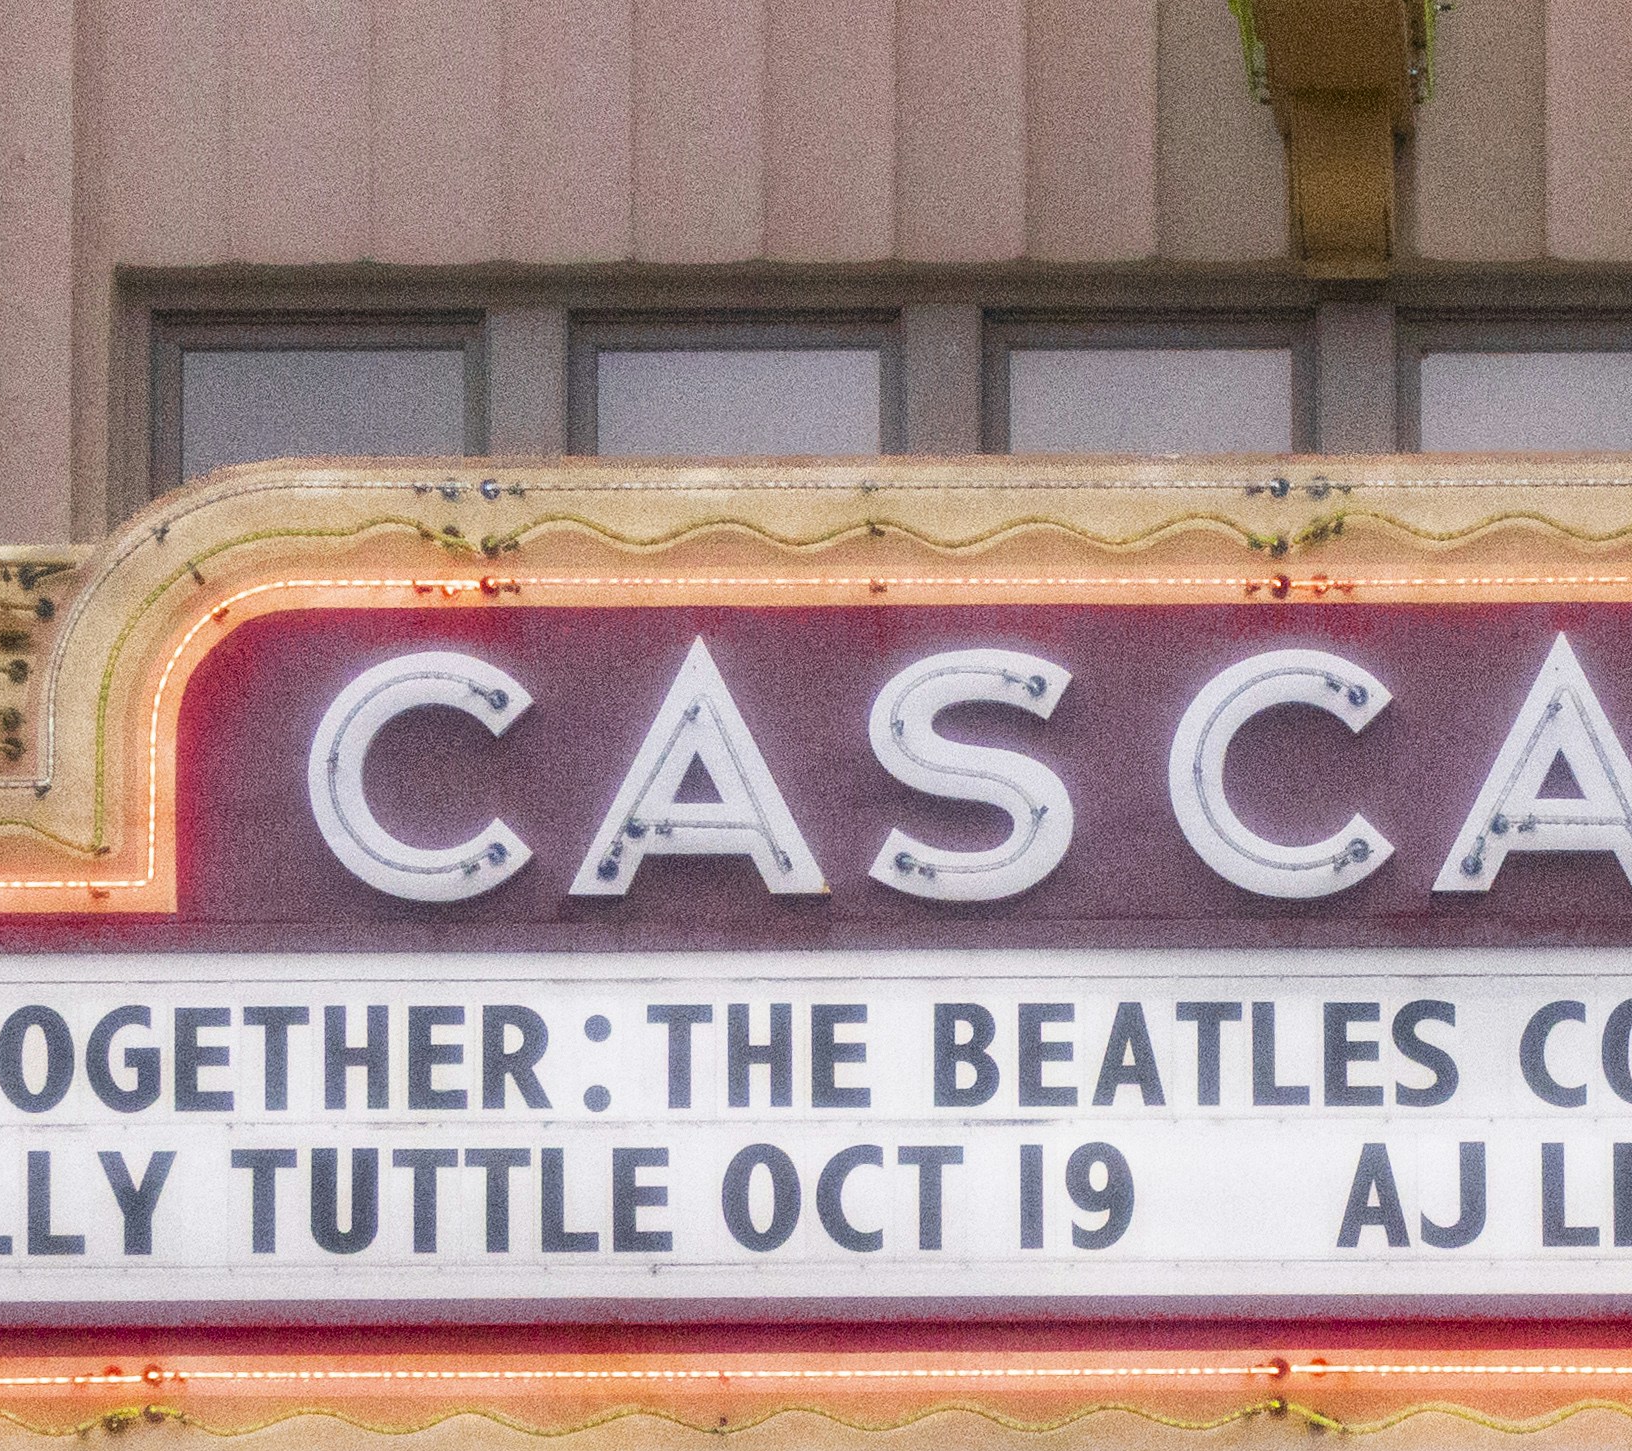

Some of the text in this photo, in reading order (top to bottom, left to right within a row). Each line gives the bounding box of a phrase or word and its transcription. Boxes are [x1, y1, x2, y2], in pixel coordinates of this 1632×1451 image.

[649, 1005, 868, 1105] THE
[935, 1002, 1457, 1105] BEATLES
[232, 1148, 671, 1254] TUTTLE
[722, 1144, 960, 1251] OCT
[1021, 1144, 1132, 1248] 19
[1338, 1144, 1484, 1246] AJ
